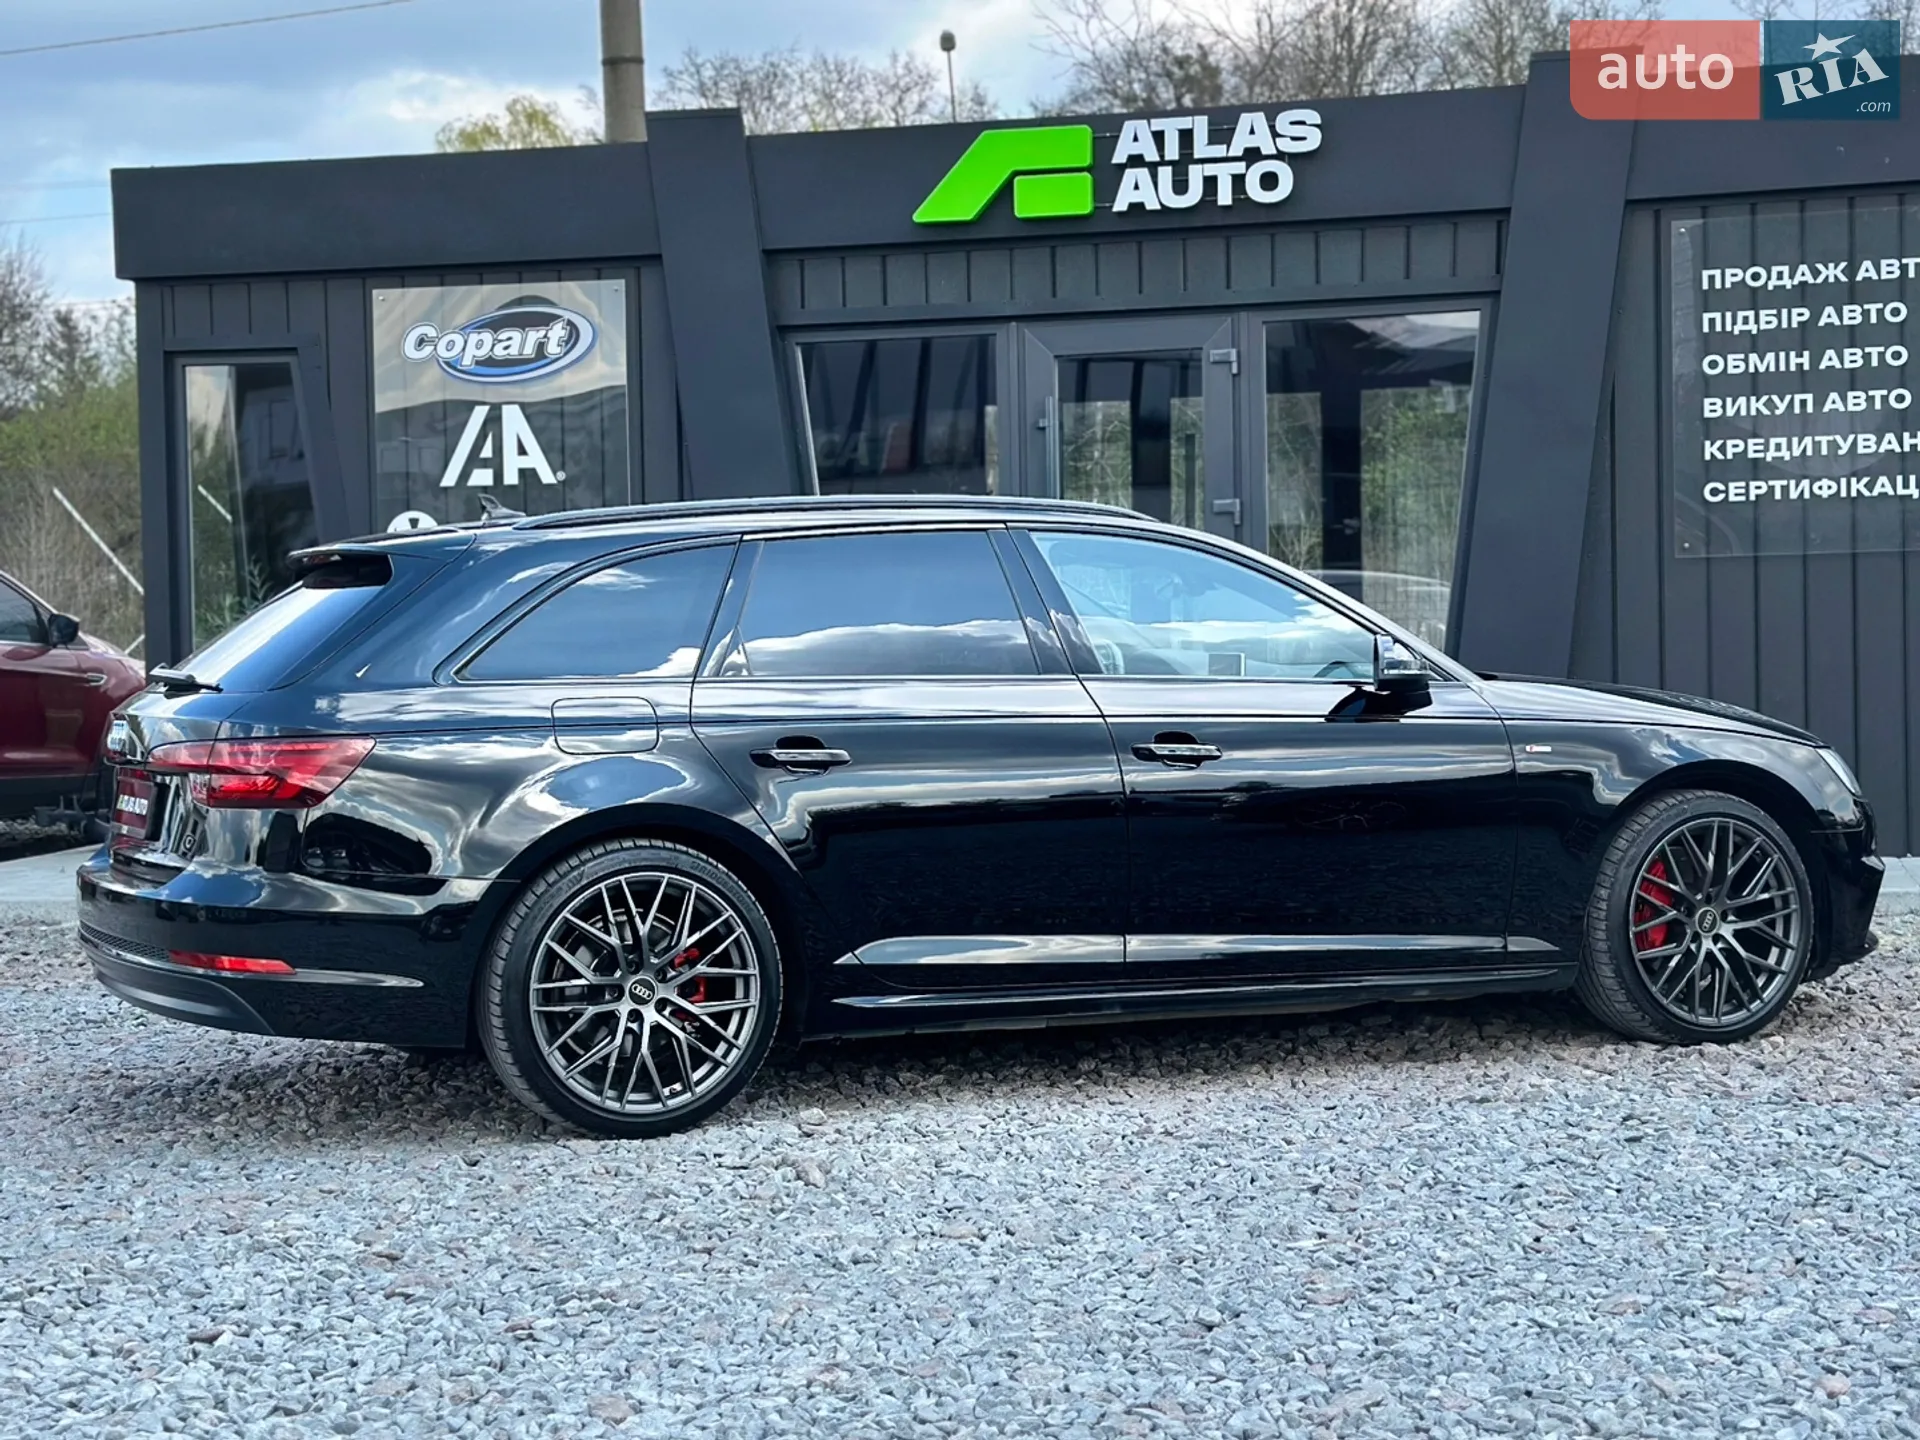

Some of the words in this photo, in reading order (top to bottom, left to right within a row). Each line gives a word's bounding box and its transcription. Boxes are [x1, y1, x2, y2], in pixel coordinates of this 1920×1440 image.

[1111, 109, 1322, 164] ATLAS
[1112, 160, 1294, 212] AUTO
[1702, 261, 1848, 290] ПРОДАЖ
[1855, 257, 1920, 281] АВТ
[1702, 307, 1811, 335] ПІДБІР
[1818, 301, 1908, 327] АВТО
[403, 315, 570, 367] Copart
[1702, 351, 1810, 375] ОБМІН
[1819, 345, 1909, 370] АВТО
[1703, 393, 1814, 419] ВИКУП
[1822, 388, 1912, 413] АВТО
[1704, 431, 1920, 462] КРЕДИТУВАН
[1703, 474, 1920, 503] СЕРТИФІКАЦ
